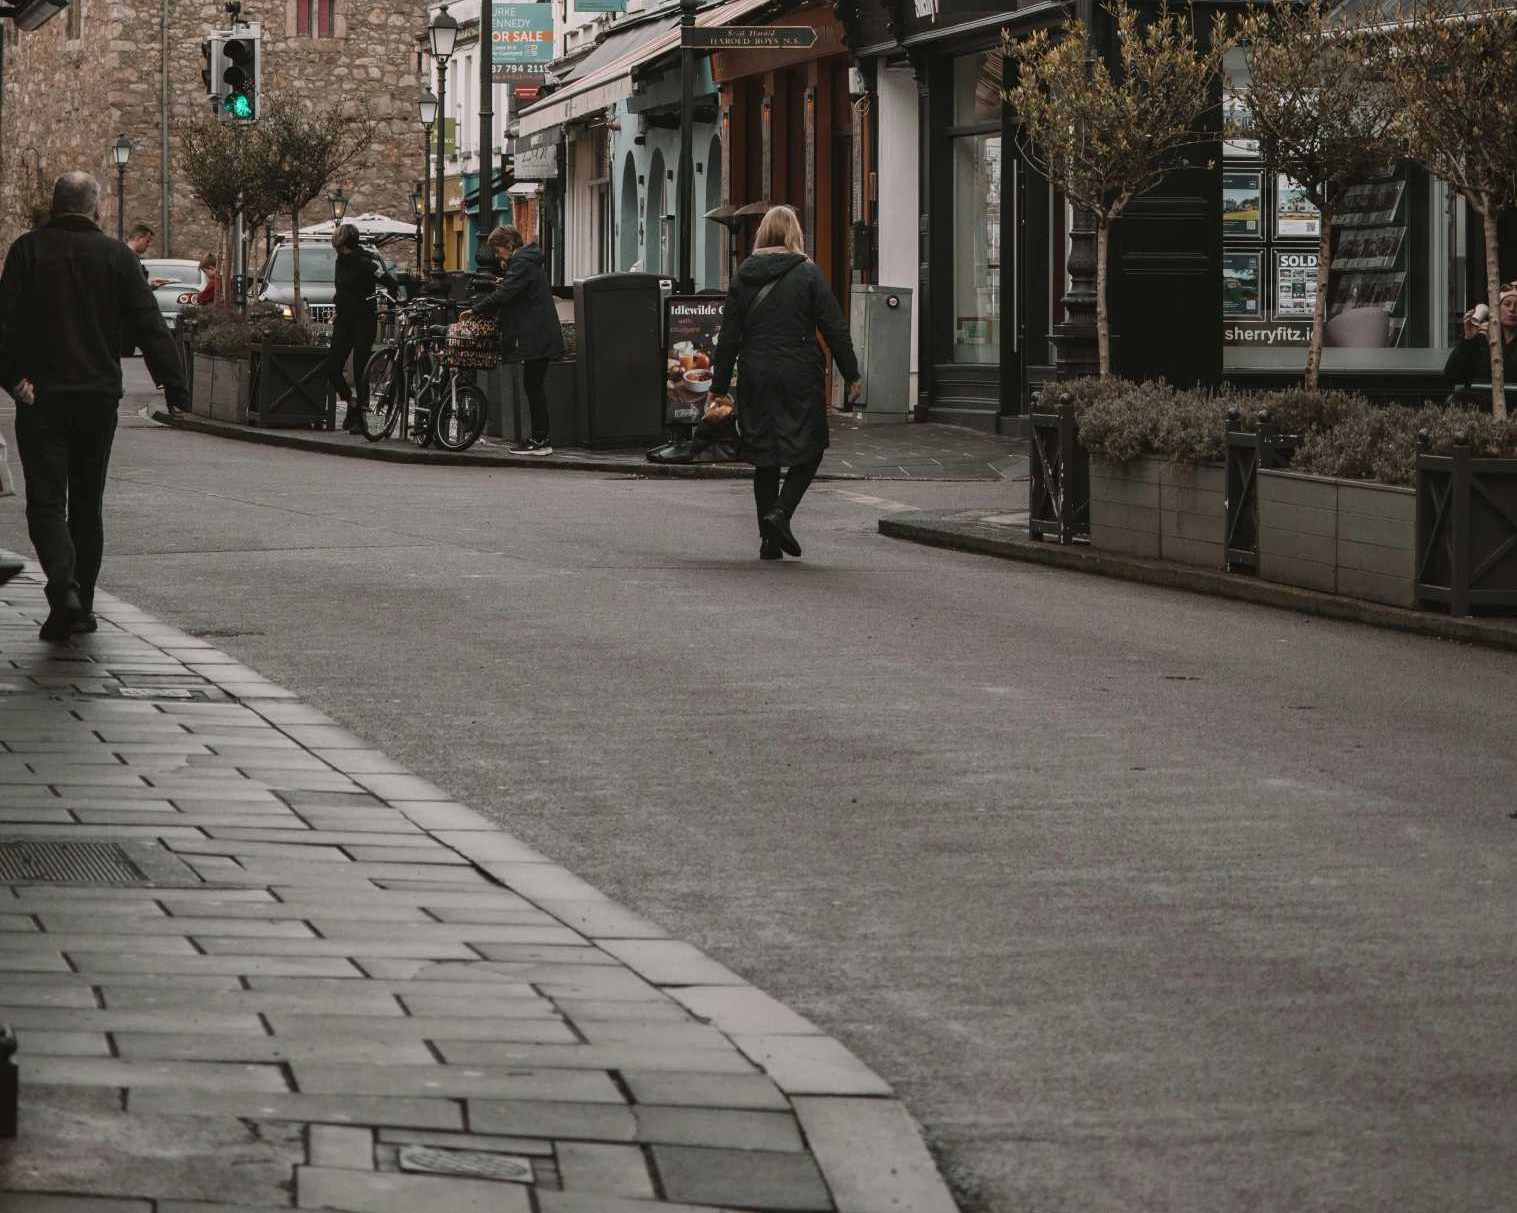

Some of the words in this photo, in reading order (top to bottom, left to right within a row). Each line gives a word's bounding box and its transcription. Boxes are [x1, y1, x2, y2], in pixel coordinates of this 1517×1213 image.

[492, 19, 531, 28] ENNEDY
[492, 32, 510, 42] OR
[513, 31, 543, 42] SALE
[505, 65, 524, 73] 794
[1280, 255, 1318, 267] SOLD
[671, 305, 717, 315] Idlewilde
